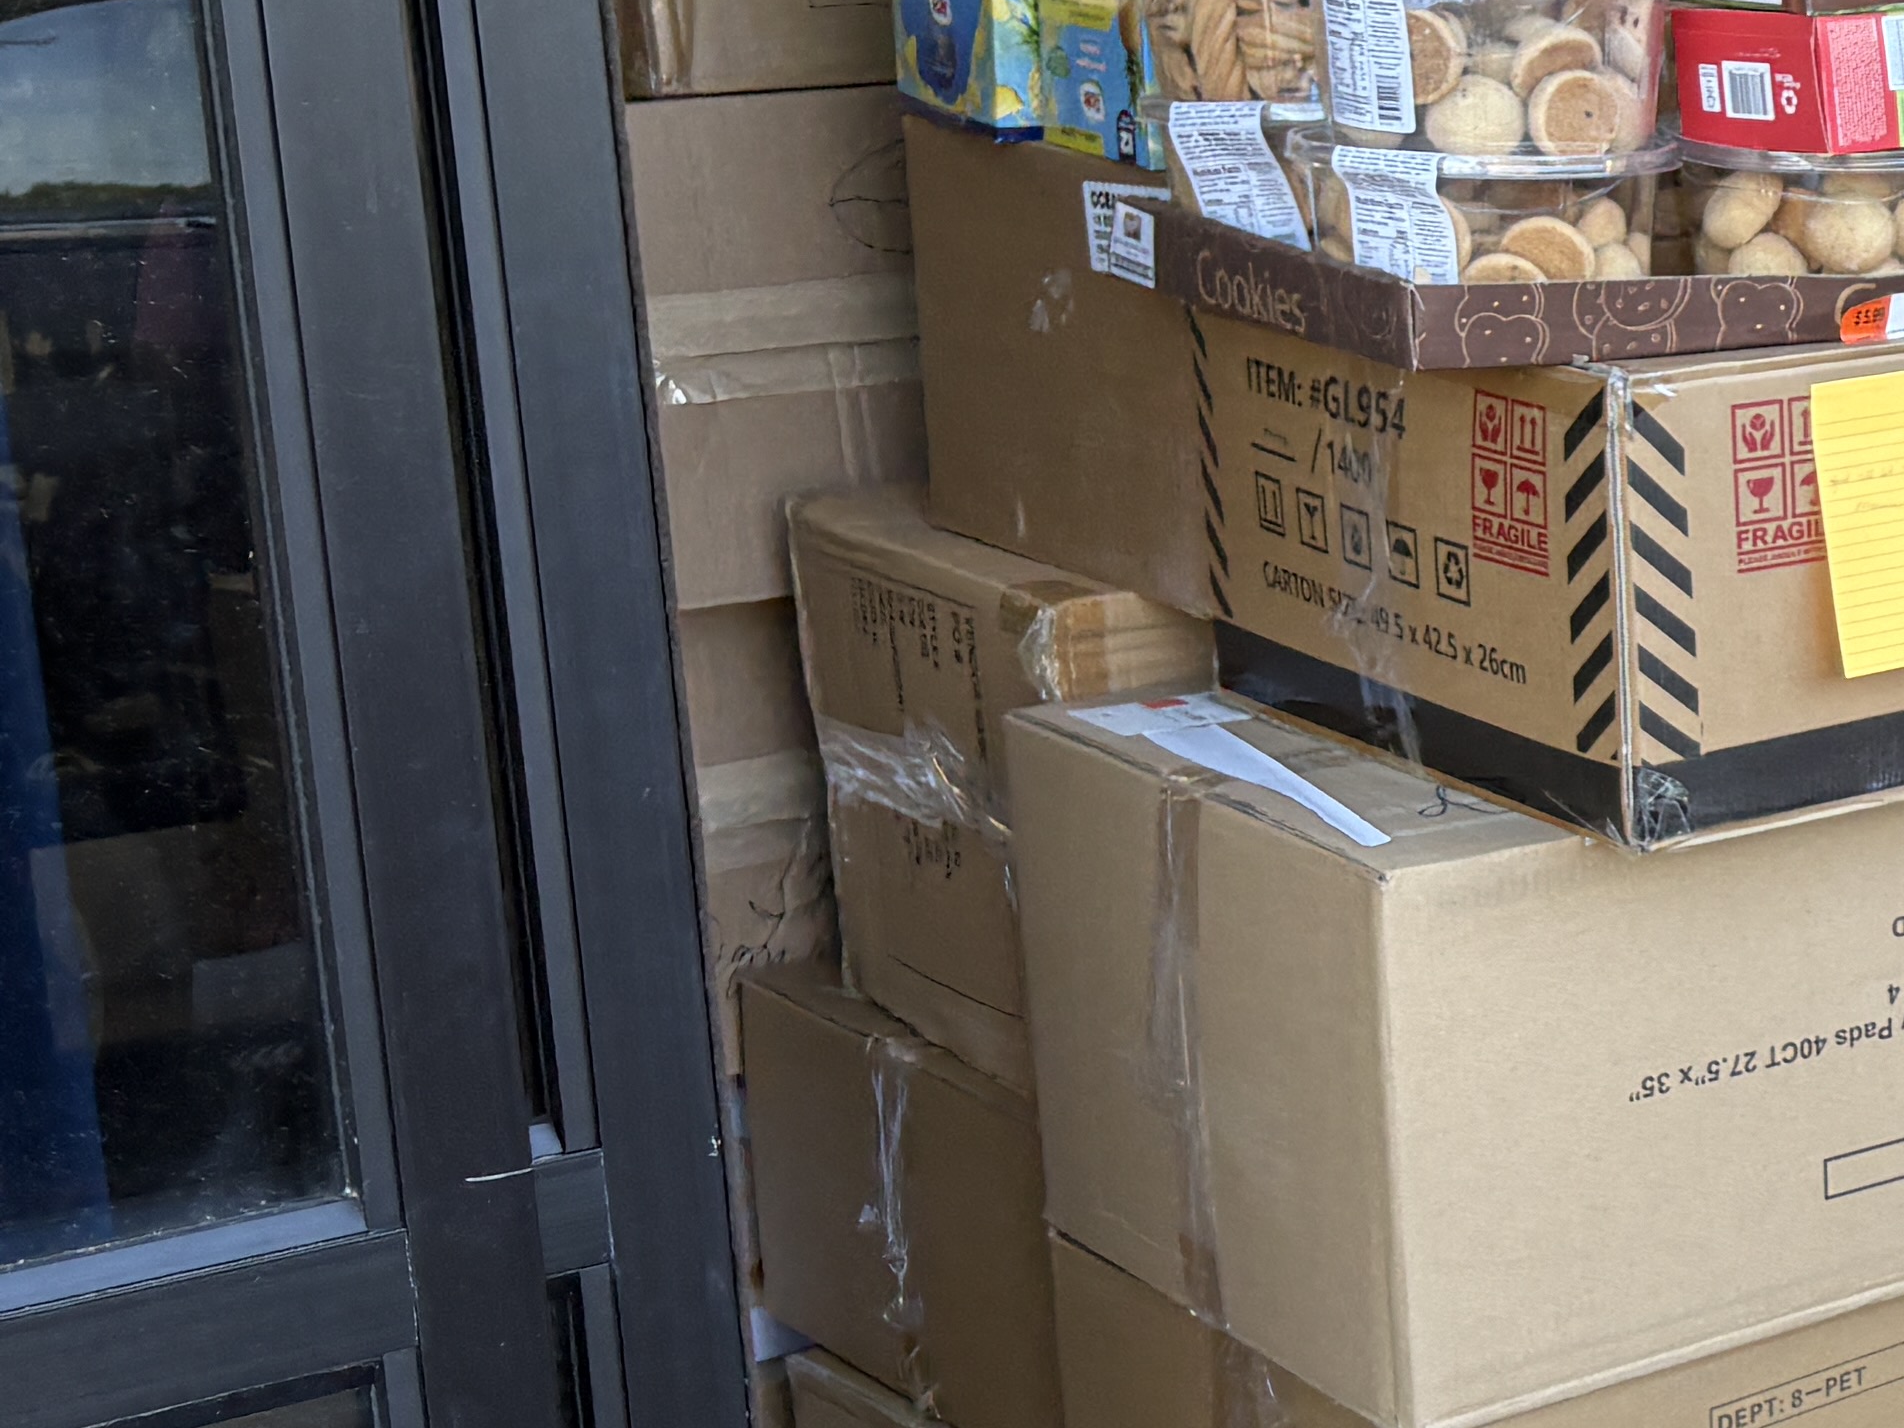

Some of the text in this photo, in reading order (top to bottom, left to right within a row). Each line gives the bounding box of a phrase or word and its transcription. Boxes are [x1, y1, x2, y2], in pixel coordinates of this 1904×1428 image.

[1197, 250, 1306, 334] Cookies
[1247, 357, 1407, 439] ITEM: #GL954
[1473, 514, 1549, 554] FRAGILE
[1736, 518, 1827, 550] FRAGIL
[1263, 560, 1326, 609] CARTON
[1423, 624, 1458, 662] 42.5
[1478, 643, 1527, 685] 26cm
[1888, 984, 1900, 1004] 4
[1834, 1018, 1892, 1047] Pads
[1765, 1035, 1827, 1069] 40CT
